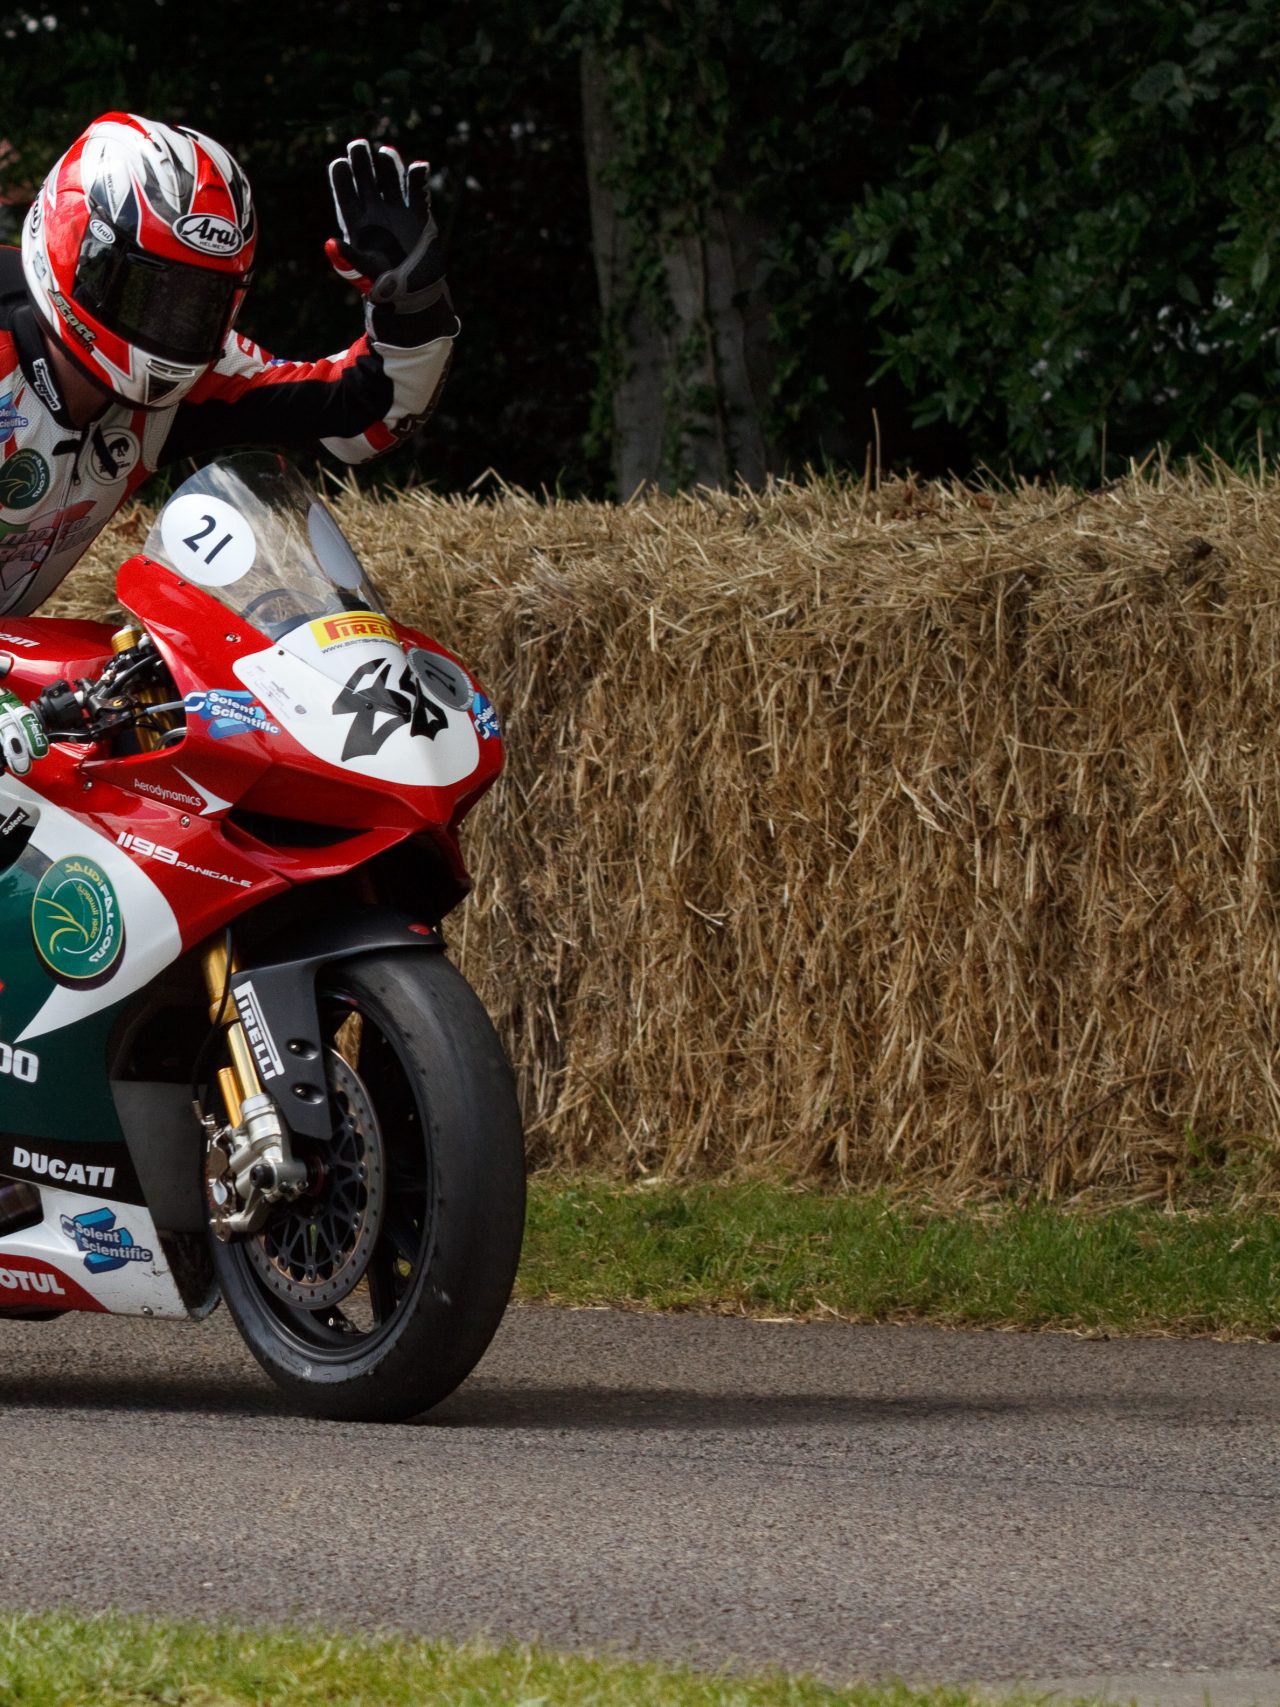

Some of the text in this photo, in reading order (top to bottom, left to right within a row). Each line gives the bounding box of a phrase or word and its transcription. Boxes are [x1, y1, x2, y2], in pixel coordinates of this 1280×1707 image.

[181, 218, 237, 248] Arai
[182, 514, 234, 565] 21
[209, 692, 255, 715] Solent
[211, 704, 279, 734] Scientific
[134, 778, 201, 806] Aerodynamics
[1, 811, 26, 836] Solent
[116, 831, 252, 888] 1199 PANIGALE
[233, 980, 285, 1081] PIRELLI
[12, 1146, 116, 1188] DUCATI
[75, 1222, 120, 1243] Solent
[81, 1238, 151, 1260] Scientific
